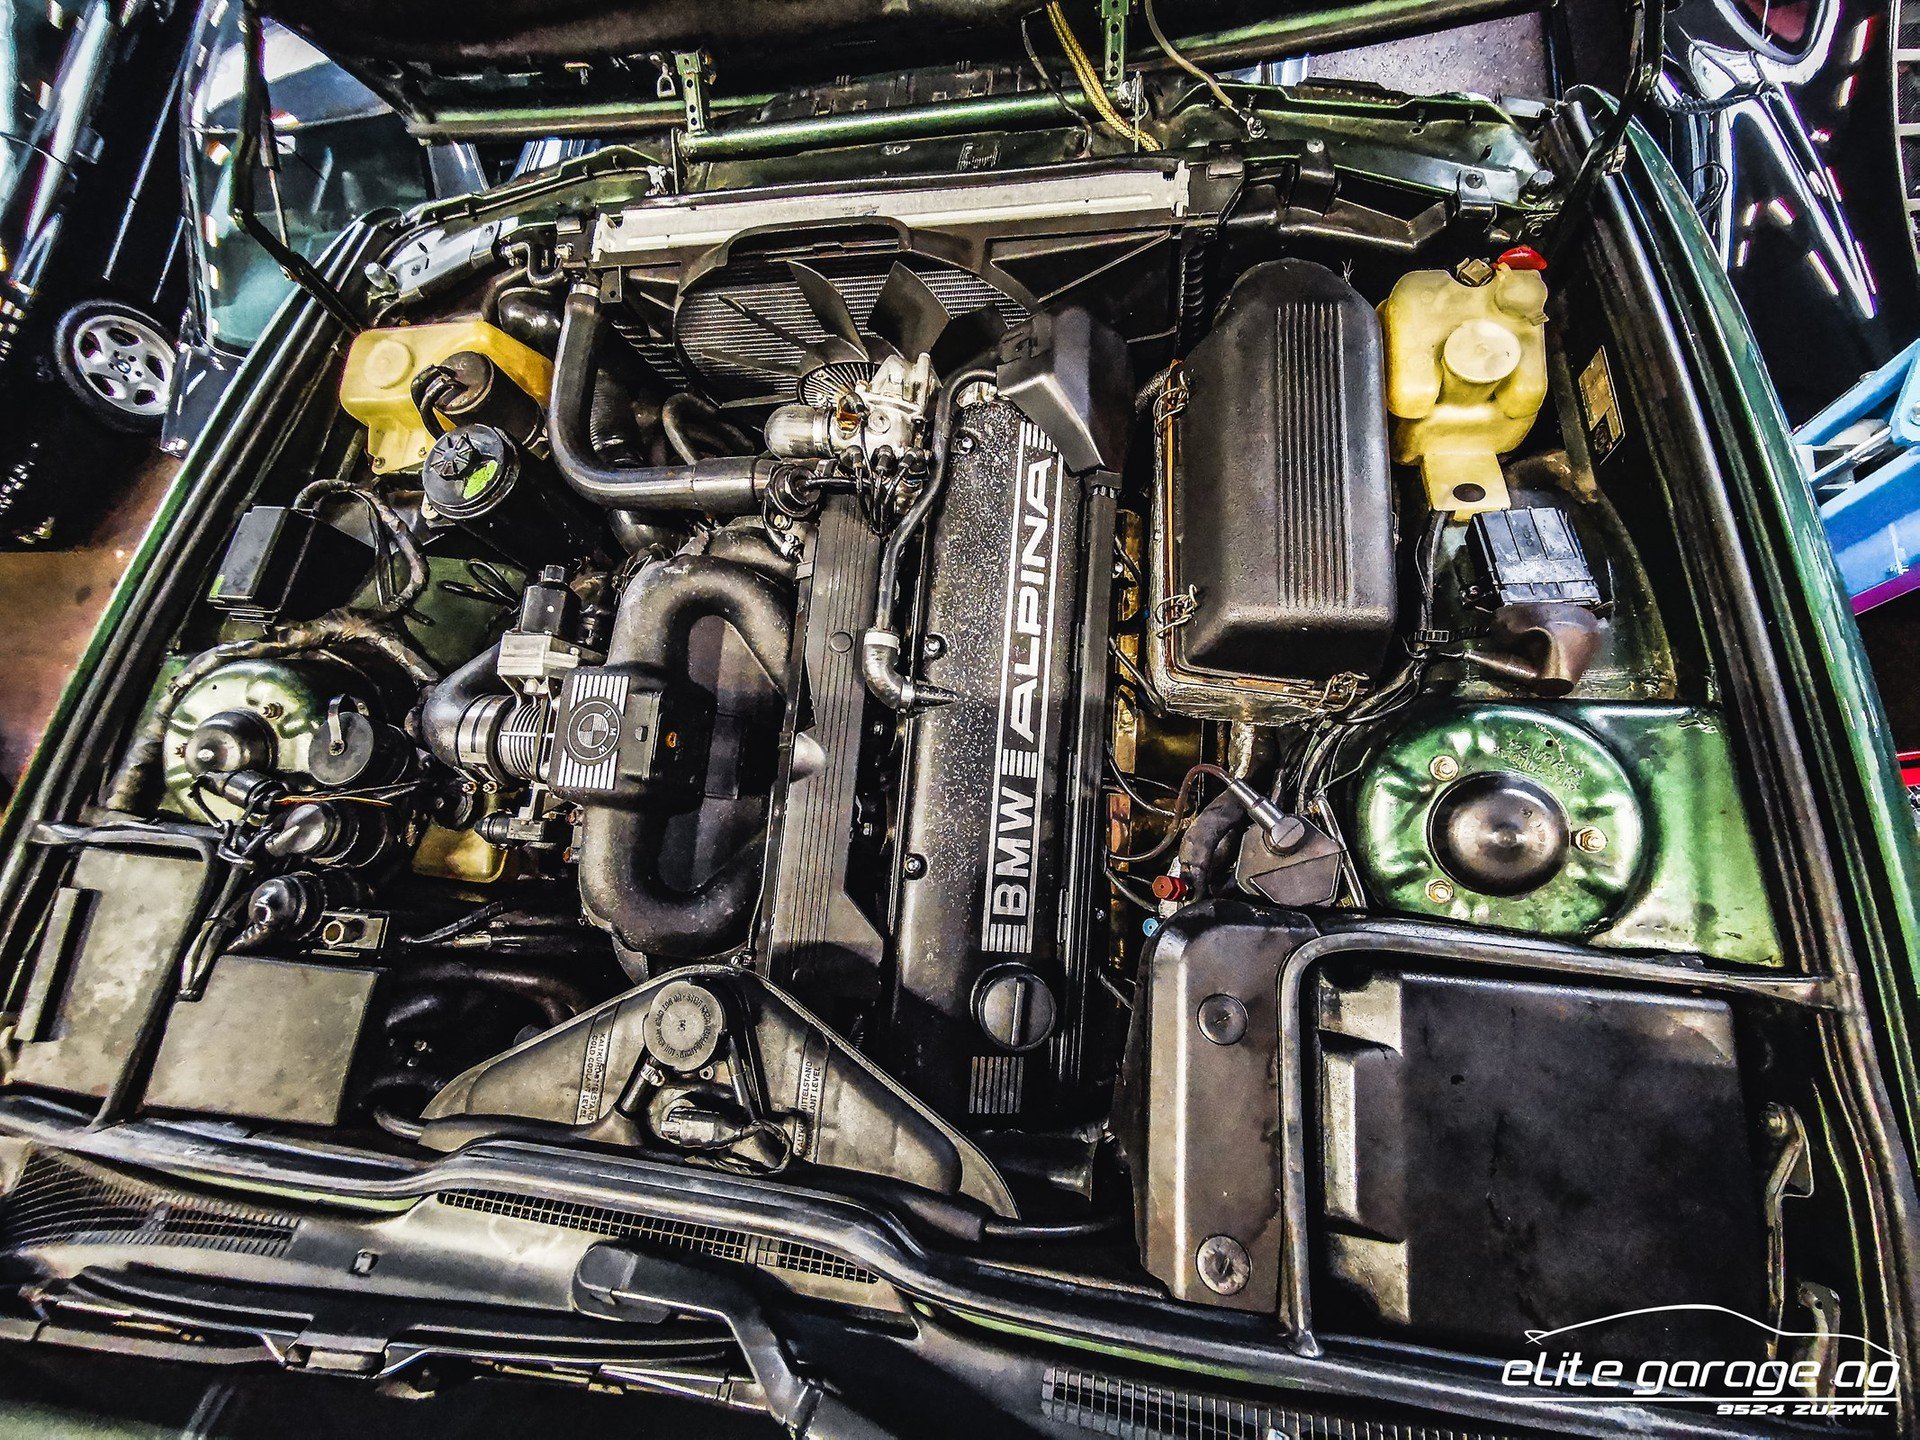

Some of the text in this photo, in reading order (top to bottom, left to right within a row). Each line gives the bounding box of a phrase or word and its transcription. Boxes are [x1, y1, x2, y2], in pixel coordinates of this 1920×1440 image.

[993, 458, 1051, 916] BMW ALPINA
[598, 709, 618, 754] BMW
[579, 1034, 598, 1118] COLD COOLANT LEVEL
[812, 1067, 821, 1093] LEVEL
